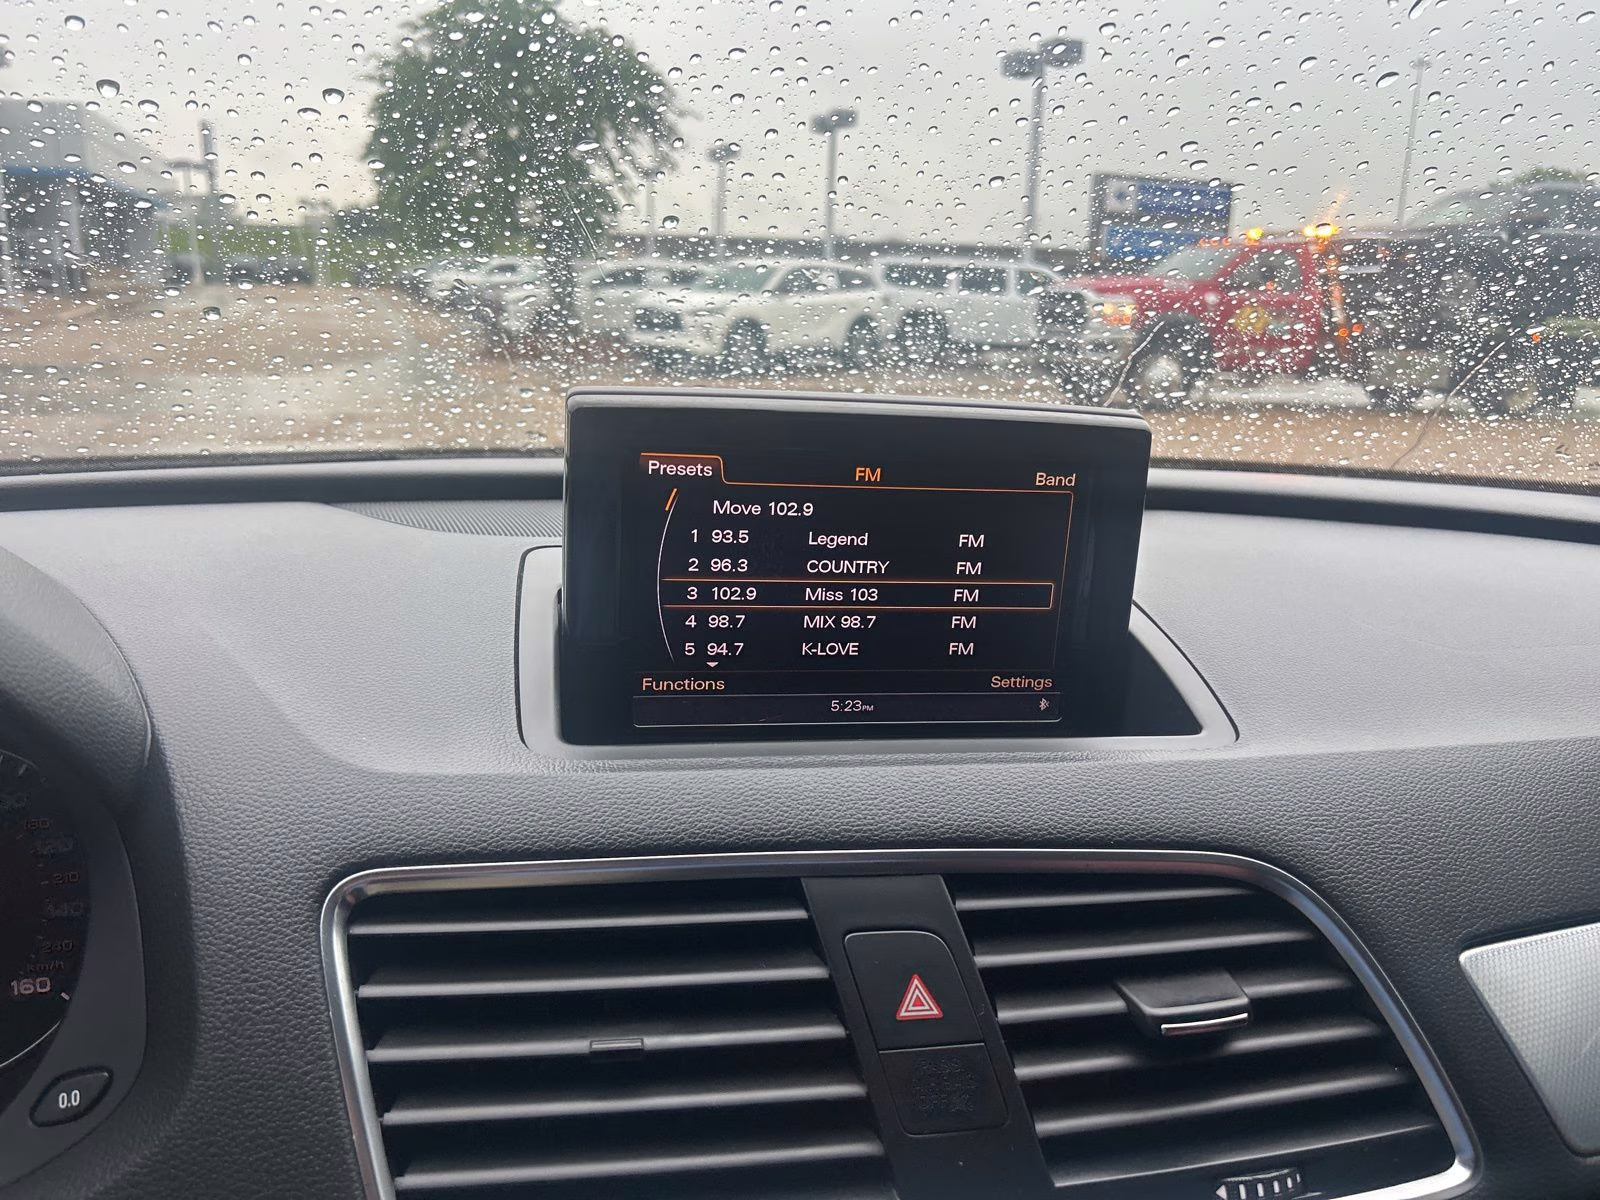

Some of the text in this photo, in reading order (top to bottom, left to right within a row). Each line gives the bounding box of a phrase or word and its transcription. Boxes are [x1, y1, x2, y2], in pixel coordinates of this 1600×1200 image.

[648, 459, 713, 477] Presets
[855, 467, 881, 482] FM
[1035, 472, 1076, 487] Band
[713, 499, 814, 517] Move 102.9
[691, 528, 985, 549] 1 93.5 Legend FM
[687, 557, 982, 575] 2 96.3 COUNTRY FM
[686, 586, 980, 602] 3 102.9 Miss 103 FM
[684, 614, 977, 629] 4 98.7 MIX 98.7 FM
[684, 642, 974, 656] 5 94.7 K-LOVE FM
[642, 677, 725, 691] Functions
[990, 675, 1053, 691] Settings
[10, 977, 52, 996] 160
[58, 1089, 80, 1109] 0.0
